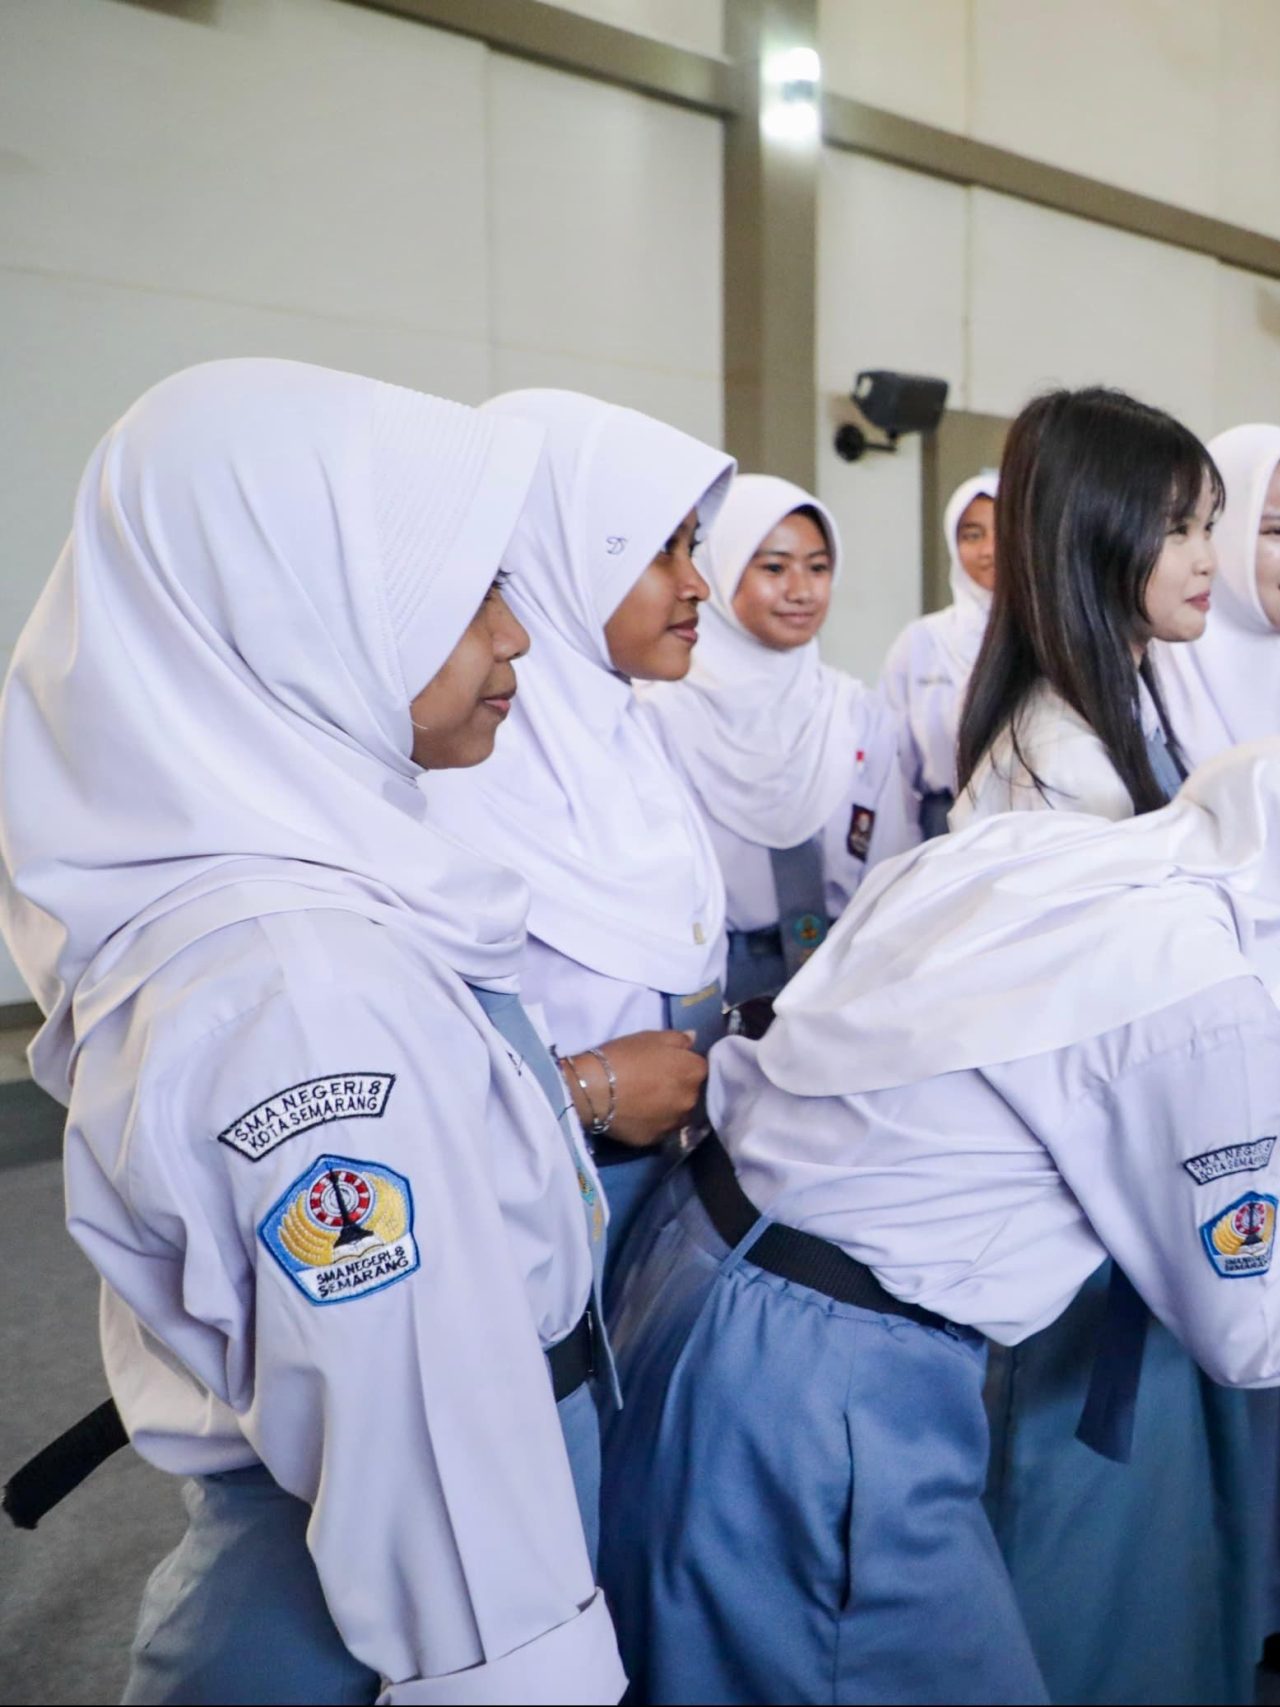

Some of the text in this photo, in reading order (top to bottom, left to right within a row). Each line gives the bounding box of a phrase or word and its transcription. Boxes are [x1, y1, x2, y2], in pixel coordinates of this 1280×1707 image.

[235, 1080, 382, 1141] SMA NEGERI 8
[248, 1096, 378, 1152] KOTA SEMARANG
[394, 1246, 405, 1257] 8
[318, 1256, 409, 1298] SEMARANG
